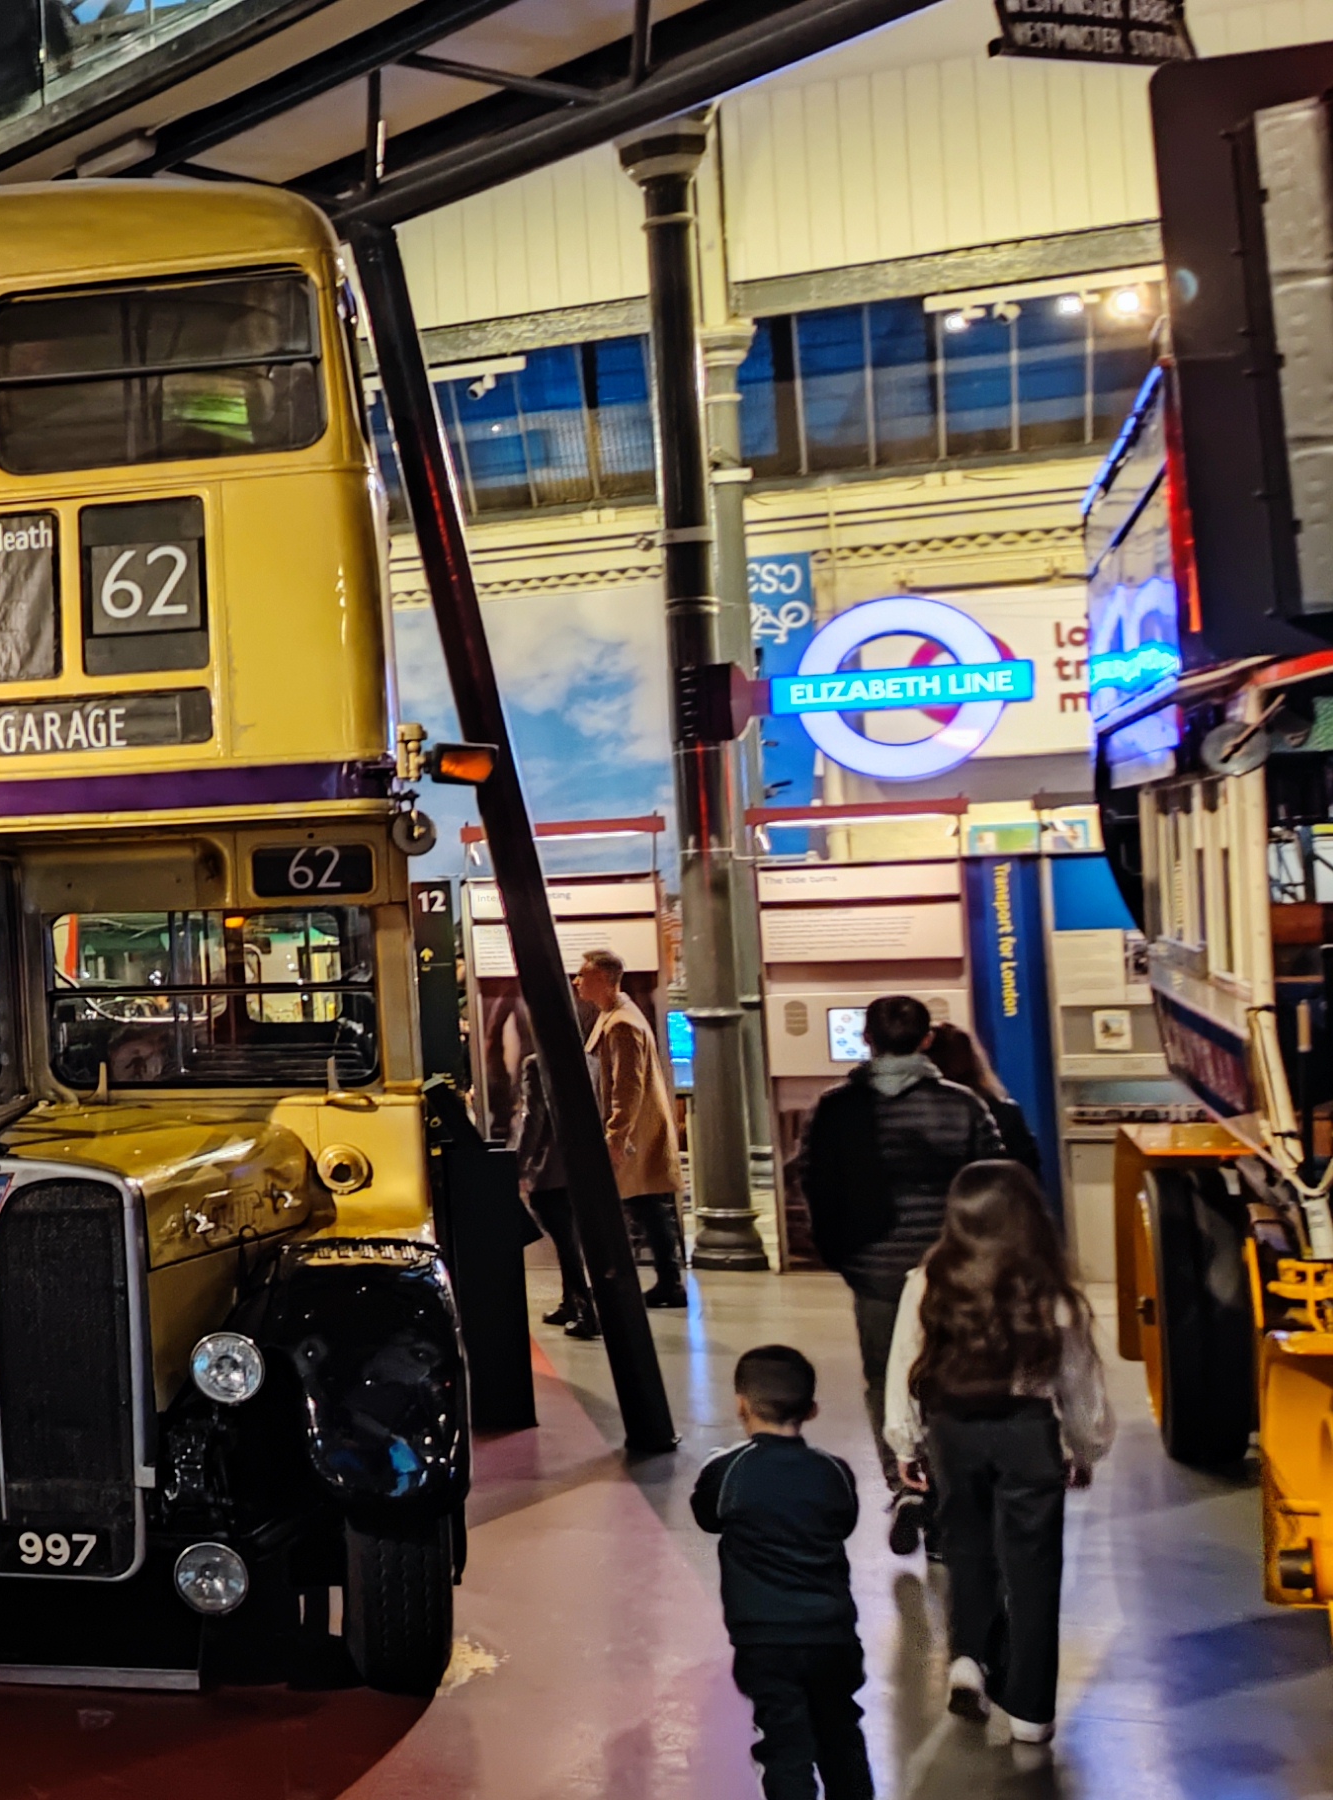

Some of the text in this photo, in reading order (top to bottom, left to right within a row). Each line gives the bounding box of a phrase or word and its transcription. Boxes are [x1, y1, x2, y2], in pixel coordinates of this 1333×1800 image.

[100, 544, 188, 619] 62
[789, 669, 1014, 705] ELIZABETH LINE
[288, 846, 342, 889] 62
[417, 890, 447, 913] 12
[992, 862, 1020, 1017] Transport for London
[18, 1531, 97, 1567] 997
